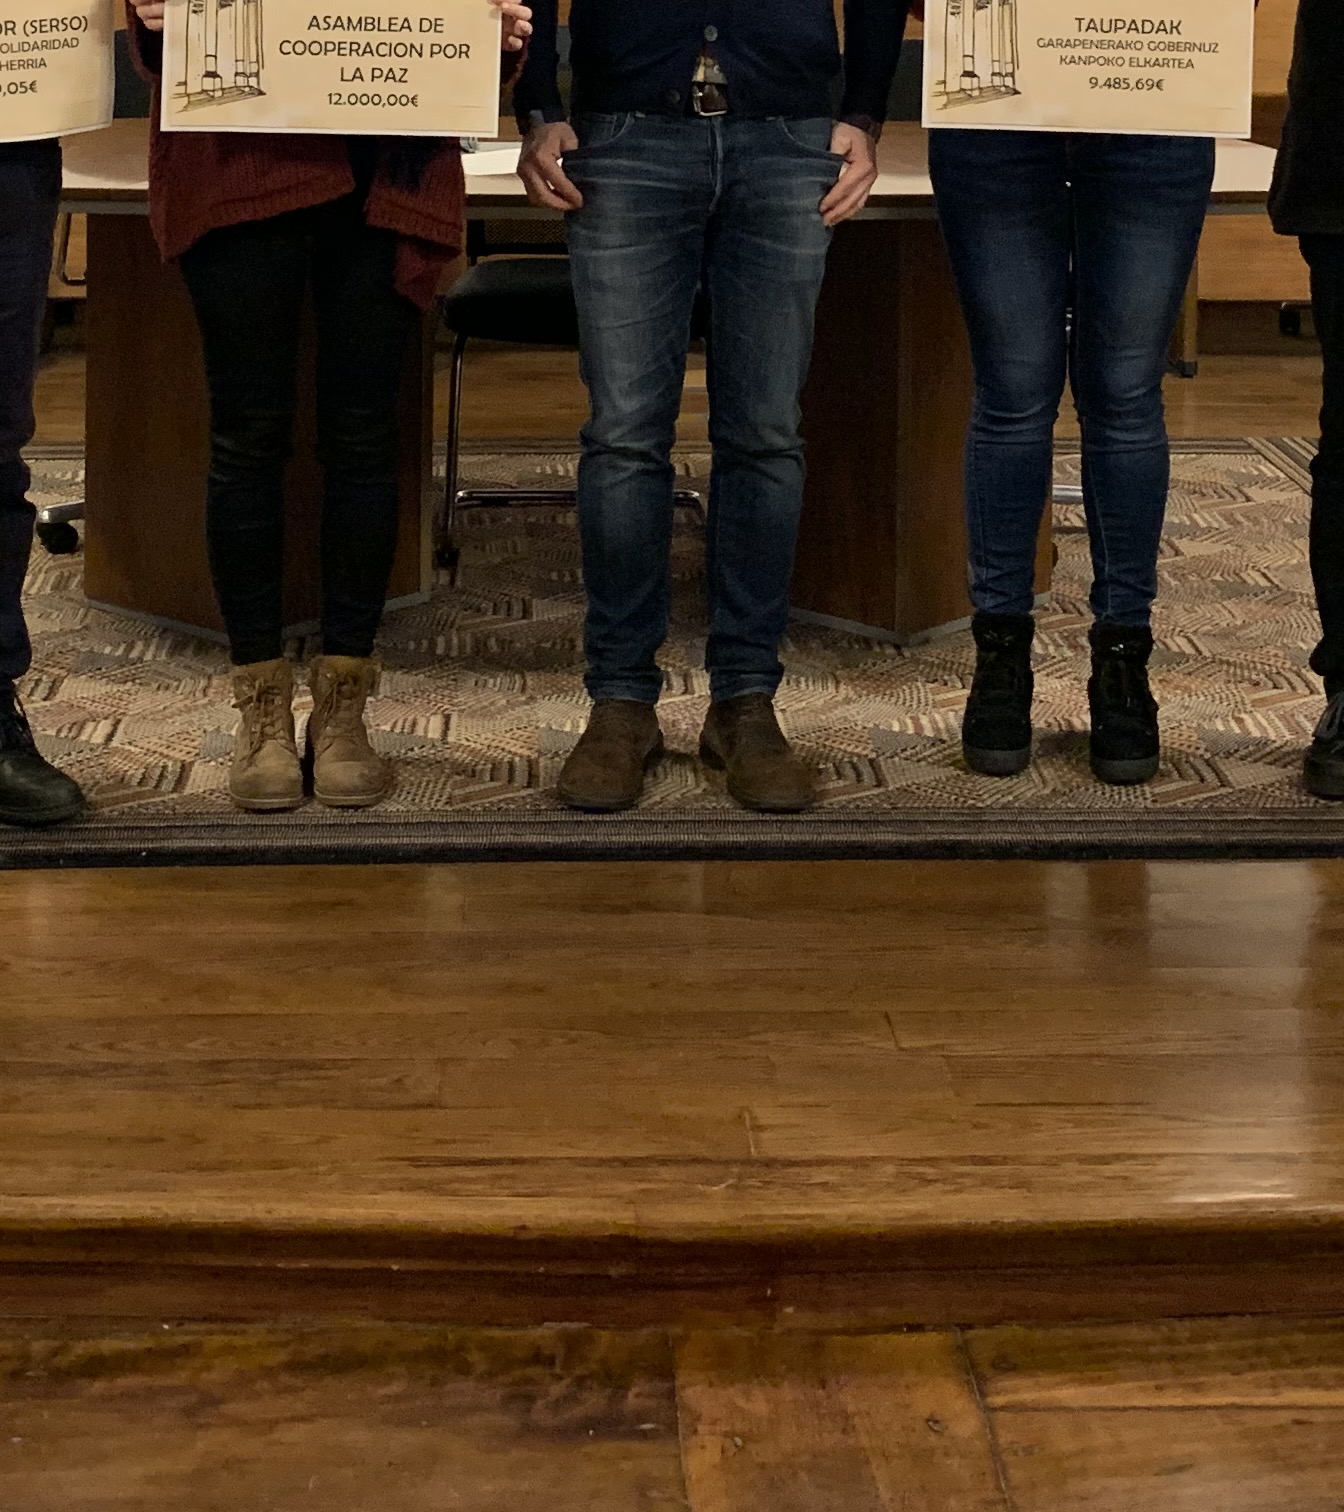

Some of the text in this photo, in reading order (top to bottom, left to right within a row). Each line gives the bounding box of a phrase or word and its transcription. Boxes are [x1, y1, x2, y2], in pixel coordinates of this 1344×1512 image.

[23, 16, 88, 38] (SERSO)
[308, 16, 444, 33] ASAMBLEA DE
[1075, 17, 1182, 35] TAUPADAK
[279, 40, 470, 59] COOPERACION POR
[1037, 37, 1219, 53] GARAPENERAKO GOBERNUZ
[0, 58, 47, 72] HERRIA
[1059, 56, 1194, 69] KANPOKO ELKARTEA
[340, 67, 408, 83] LA PAZ
[1089, 76, 1164, 91] 9.485,69€
[327, 93, 418, 108] 12.000,00€
